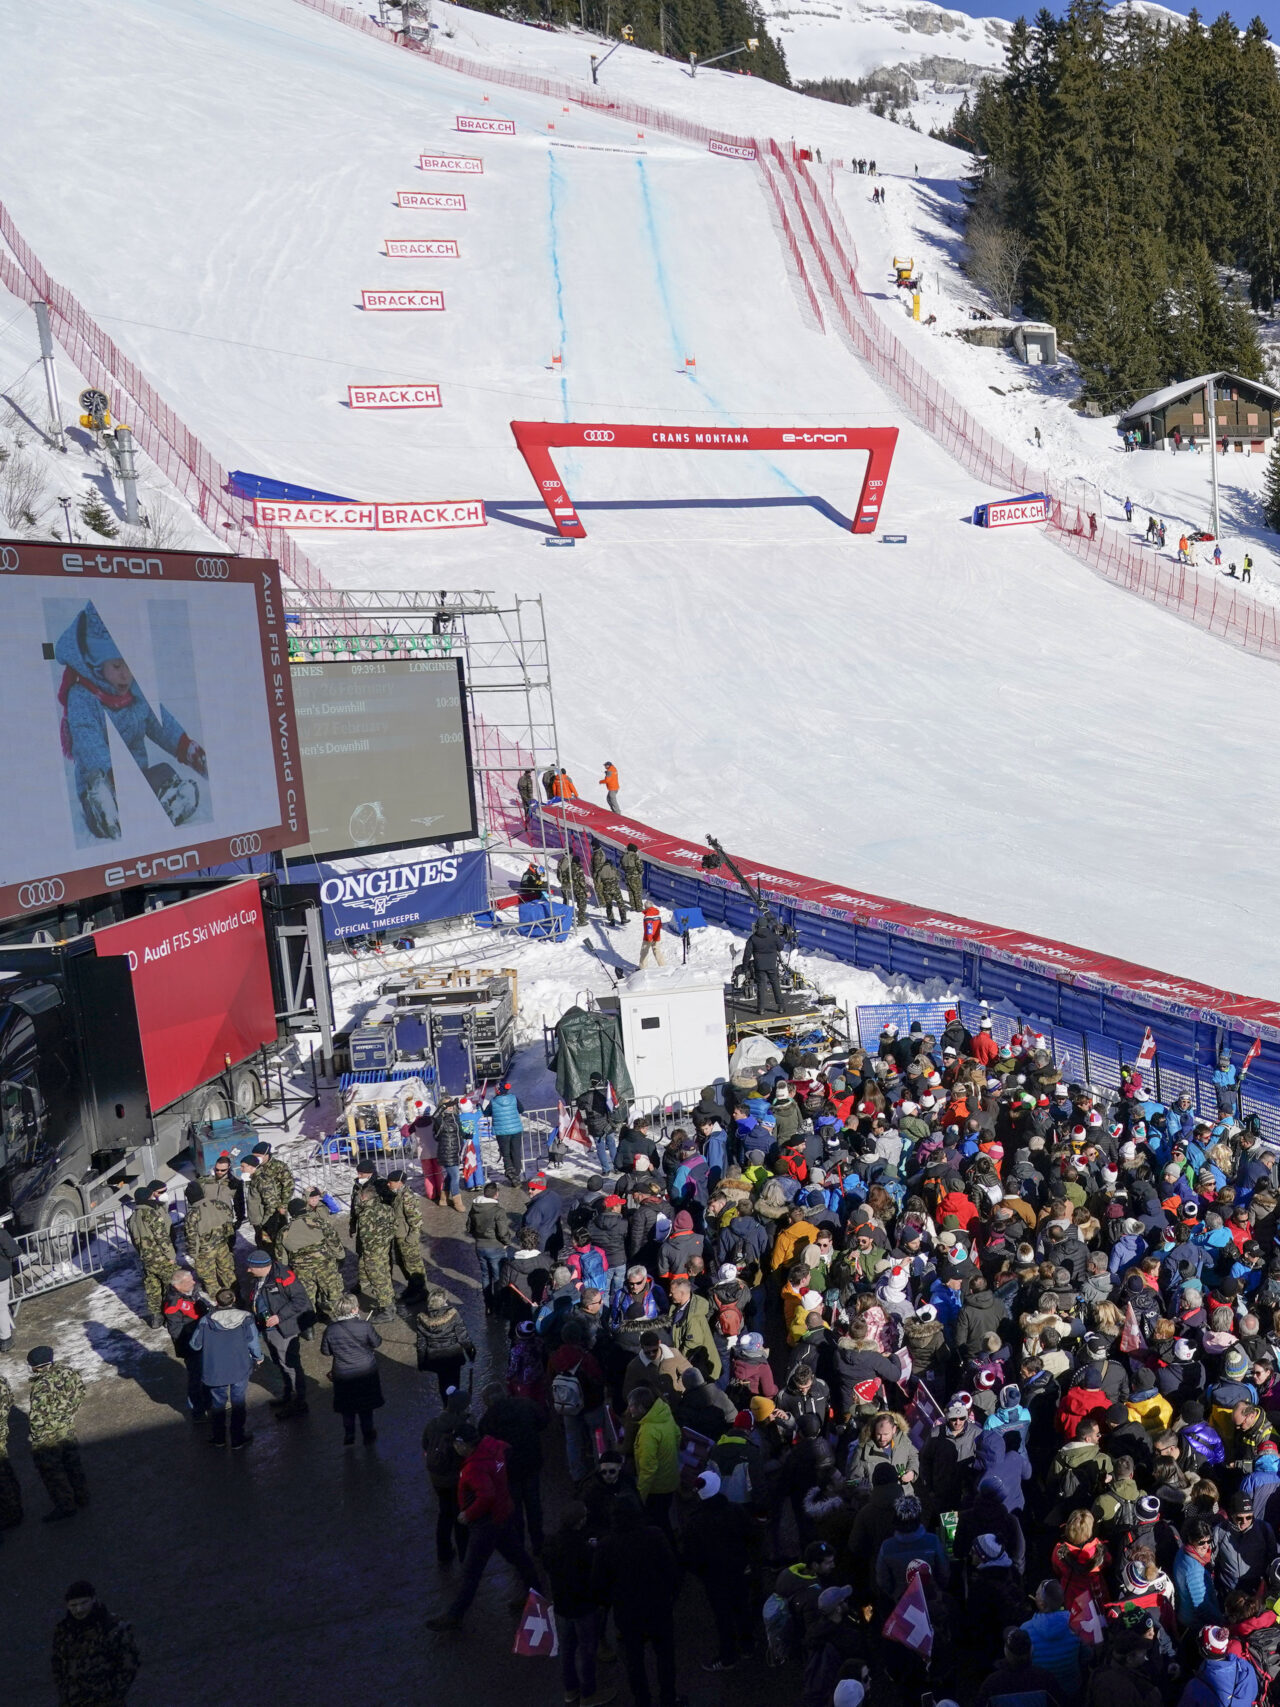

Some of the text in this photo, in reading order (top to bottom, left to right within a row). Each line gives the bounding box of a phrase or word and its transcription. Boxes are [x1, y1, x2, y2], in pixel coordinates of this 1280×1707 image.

[460, 120, 512, 132] BRACK.CH
[711, 143, 754, 157] BRACK.CH
[424, 159, 480, 171] BRACK.CH
[402, 196, 462, 207] BRACK.CH
[391, 244, 454, 254] BRACK.CH
[367, 295, 440, 307] BRACK.CH
[354, 390, 436, 404] BRACK.CH
[652, 432, 847, 444] CRANS MONTANA e-tron
[262, 507, 373, 523] BRACK.CH
[382, 507, 479, 524] BRACK.CH
[991, 505, 1043, 522] BRACK.CH
[61, 553, 163, 575] e-tron
[290, 666, 324, 677] GINES
[351, 664, 386, 675] 09:39:11
[409, 662, 457, 673] LONGINES
[261, 572, 299, 832] Audi FIS Ski World Cup
[322, 701, 366, 715] Downhill
[439, 732, 464, 744] 10:00
[326, 739, 370, 754] Downhill
[104, 849, 200, 886] e-tron
[320, 858, 458, 904] ONGINES
[334, 912, 420, 937] OFFICIAL TIMEKEEPER
[143, 909, 258, 964] Audi FIS Ski World Cup
